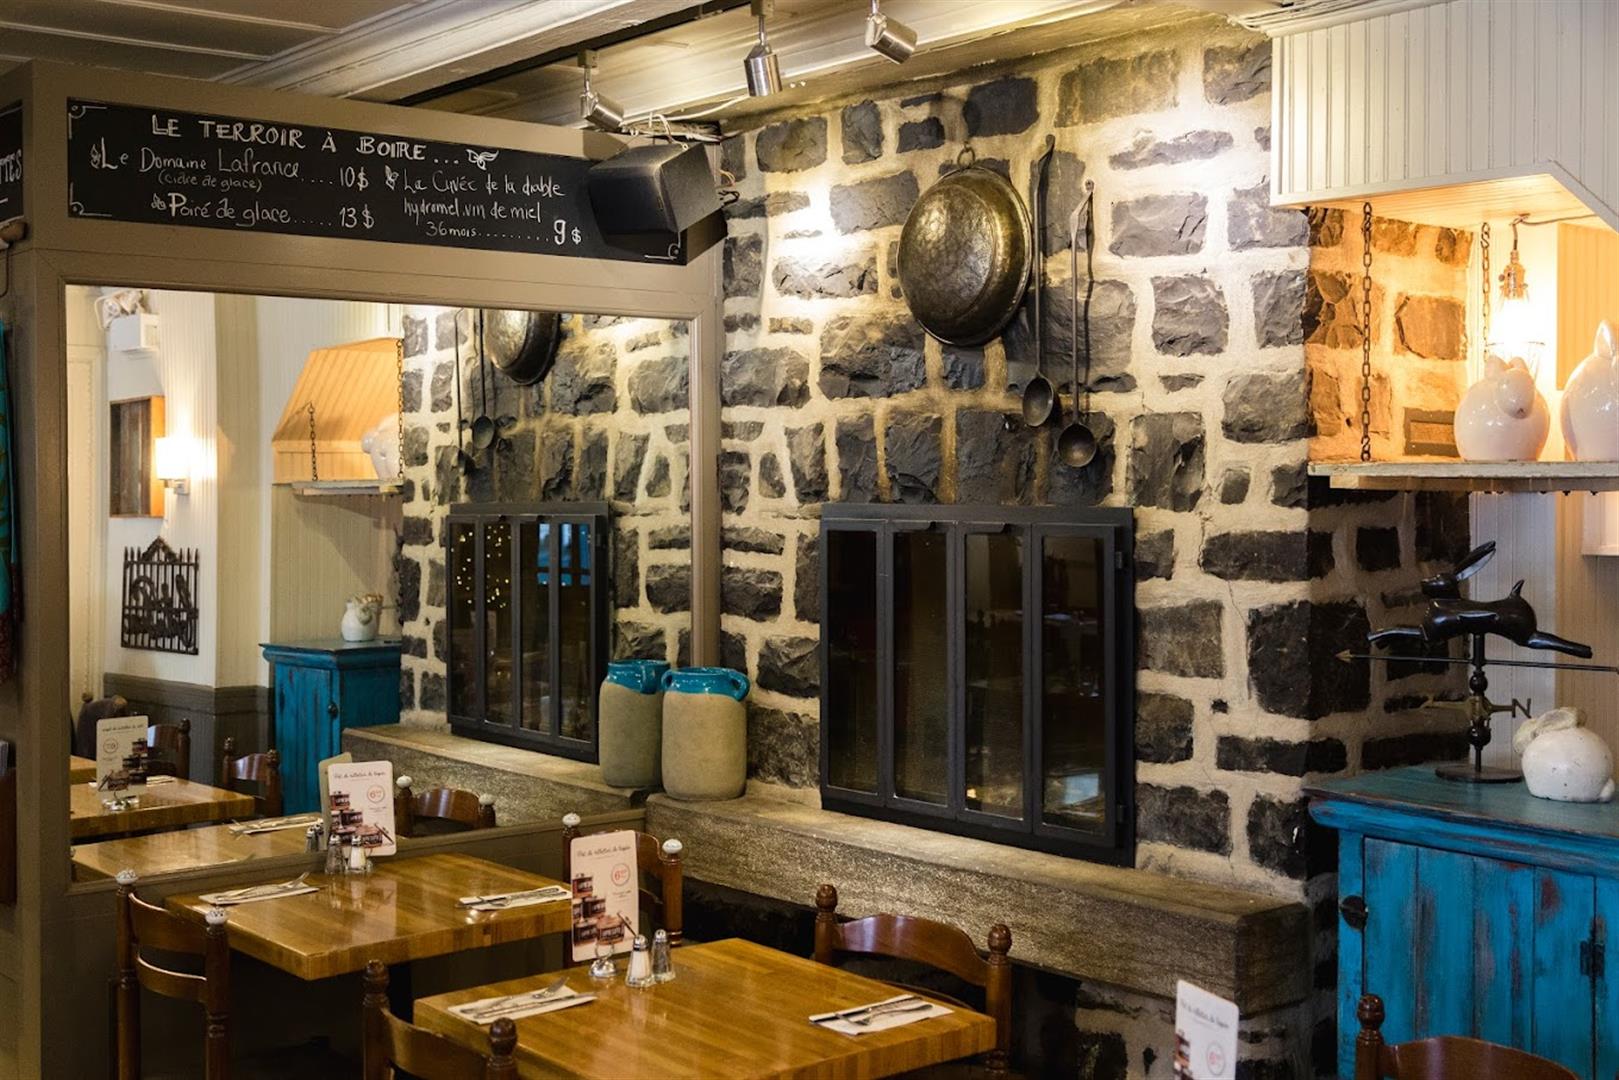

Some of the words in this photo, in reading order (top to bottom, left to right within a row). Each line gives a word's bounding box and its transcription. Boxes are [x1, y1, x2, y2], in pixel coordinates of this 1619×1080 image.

[151, 114, 181, 137] LE
[198, 120, 306, 149] TERROIR
[321, 131, 337, 153] À
[101, 137, 129, 170] Le
[139, 146, 207, 173] Domaine
[403, 168, 427, 194] La
[485, 173, 499, 195] de
[504, 174, 517, 194] la
[522, 175, 566, 198] diable
[167, 192, 212, 217] Poiré
[215, 197, 236, 219] de
[235, 200, 292, 228] glace
[489, 201, 508, 220] de
[510, 201, 542, 223] miel
